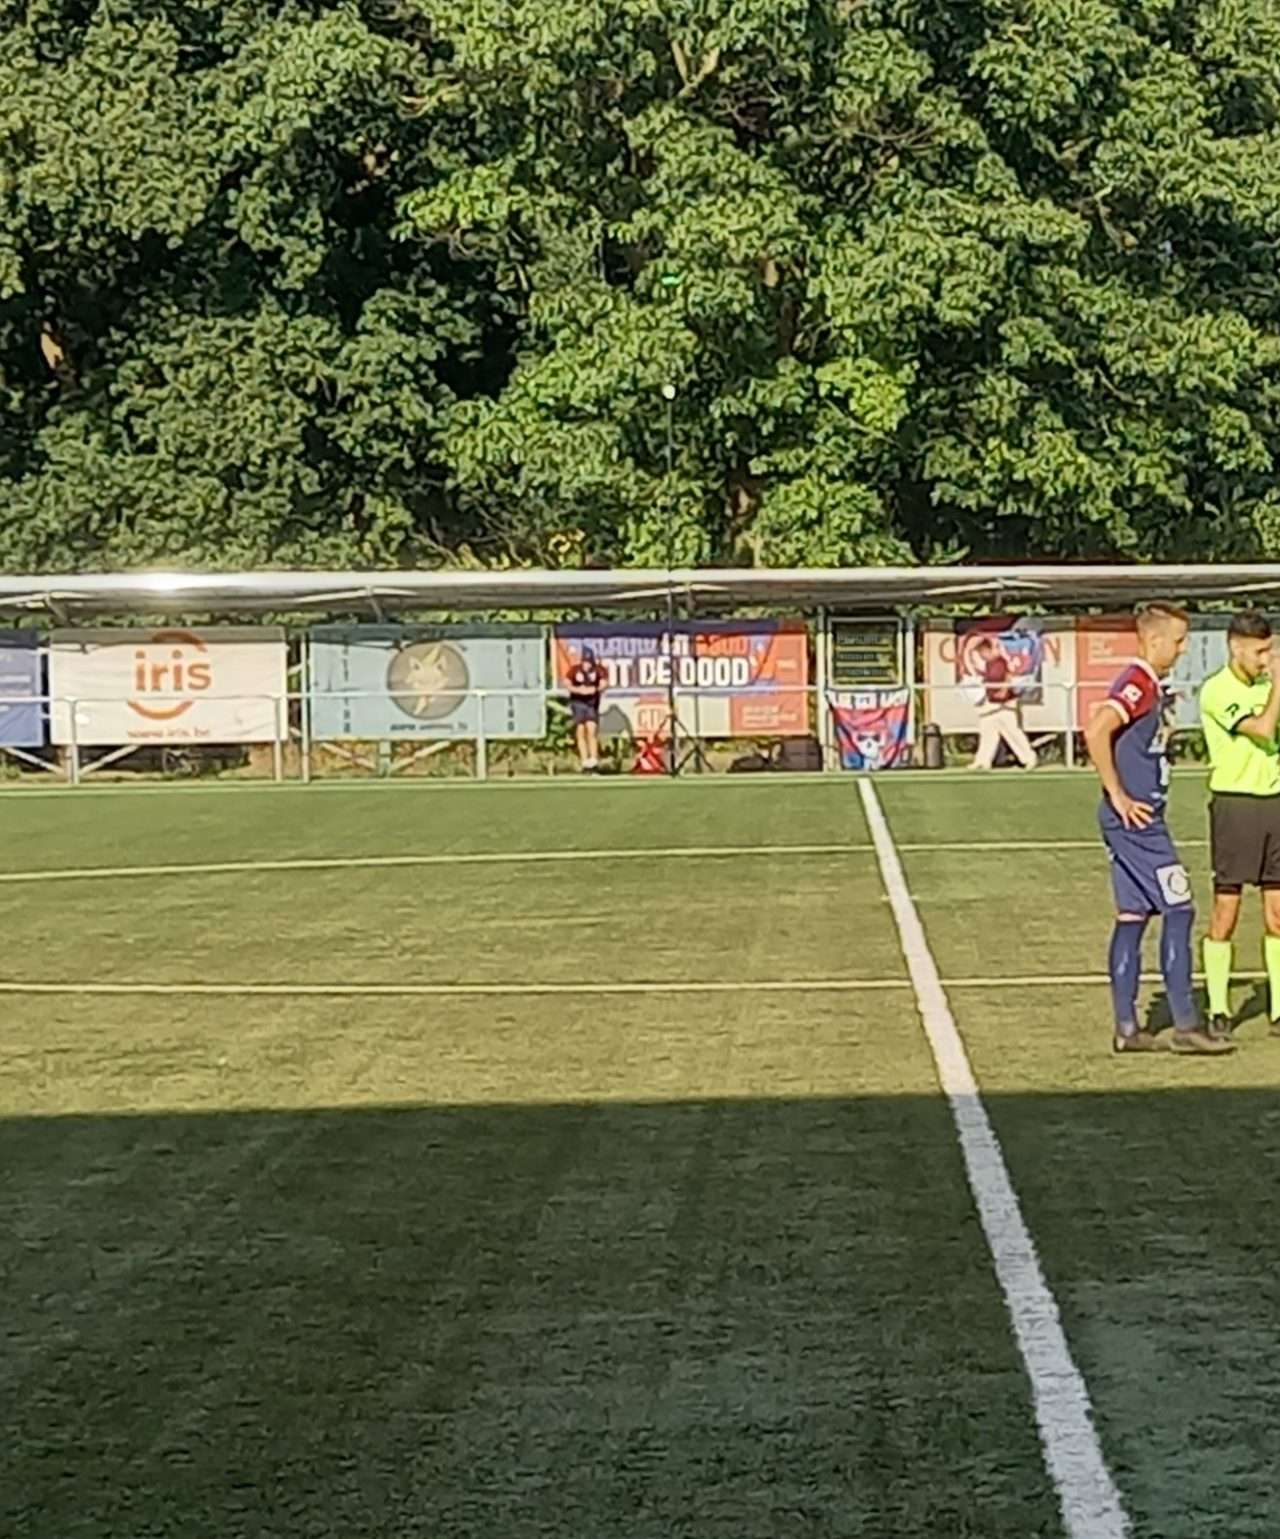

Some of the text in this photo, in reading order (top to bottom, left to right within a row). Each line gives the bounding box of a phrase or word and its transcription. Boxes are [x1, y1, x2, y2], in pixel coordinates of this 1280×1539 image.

[135, 649, 211, 691] iris
[639, 656, 671, 685] DE
[679, 656, 749, 686] DOOD
